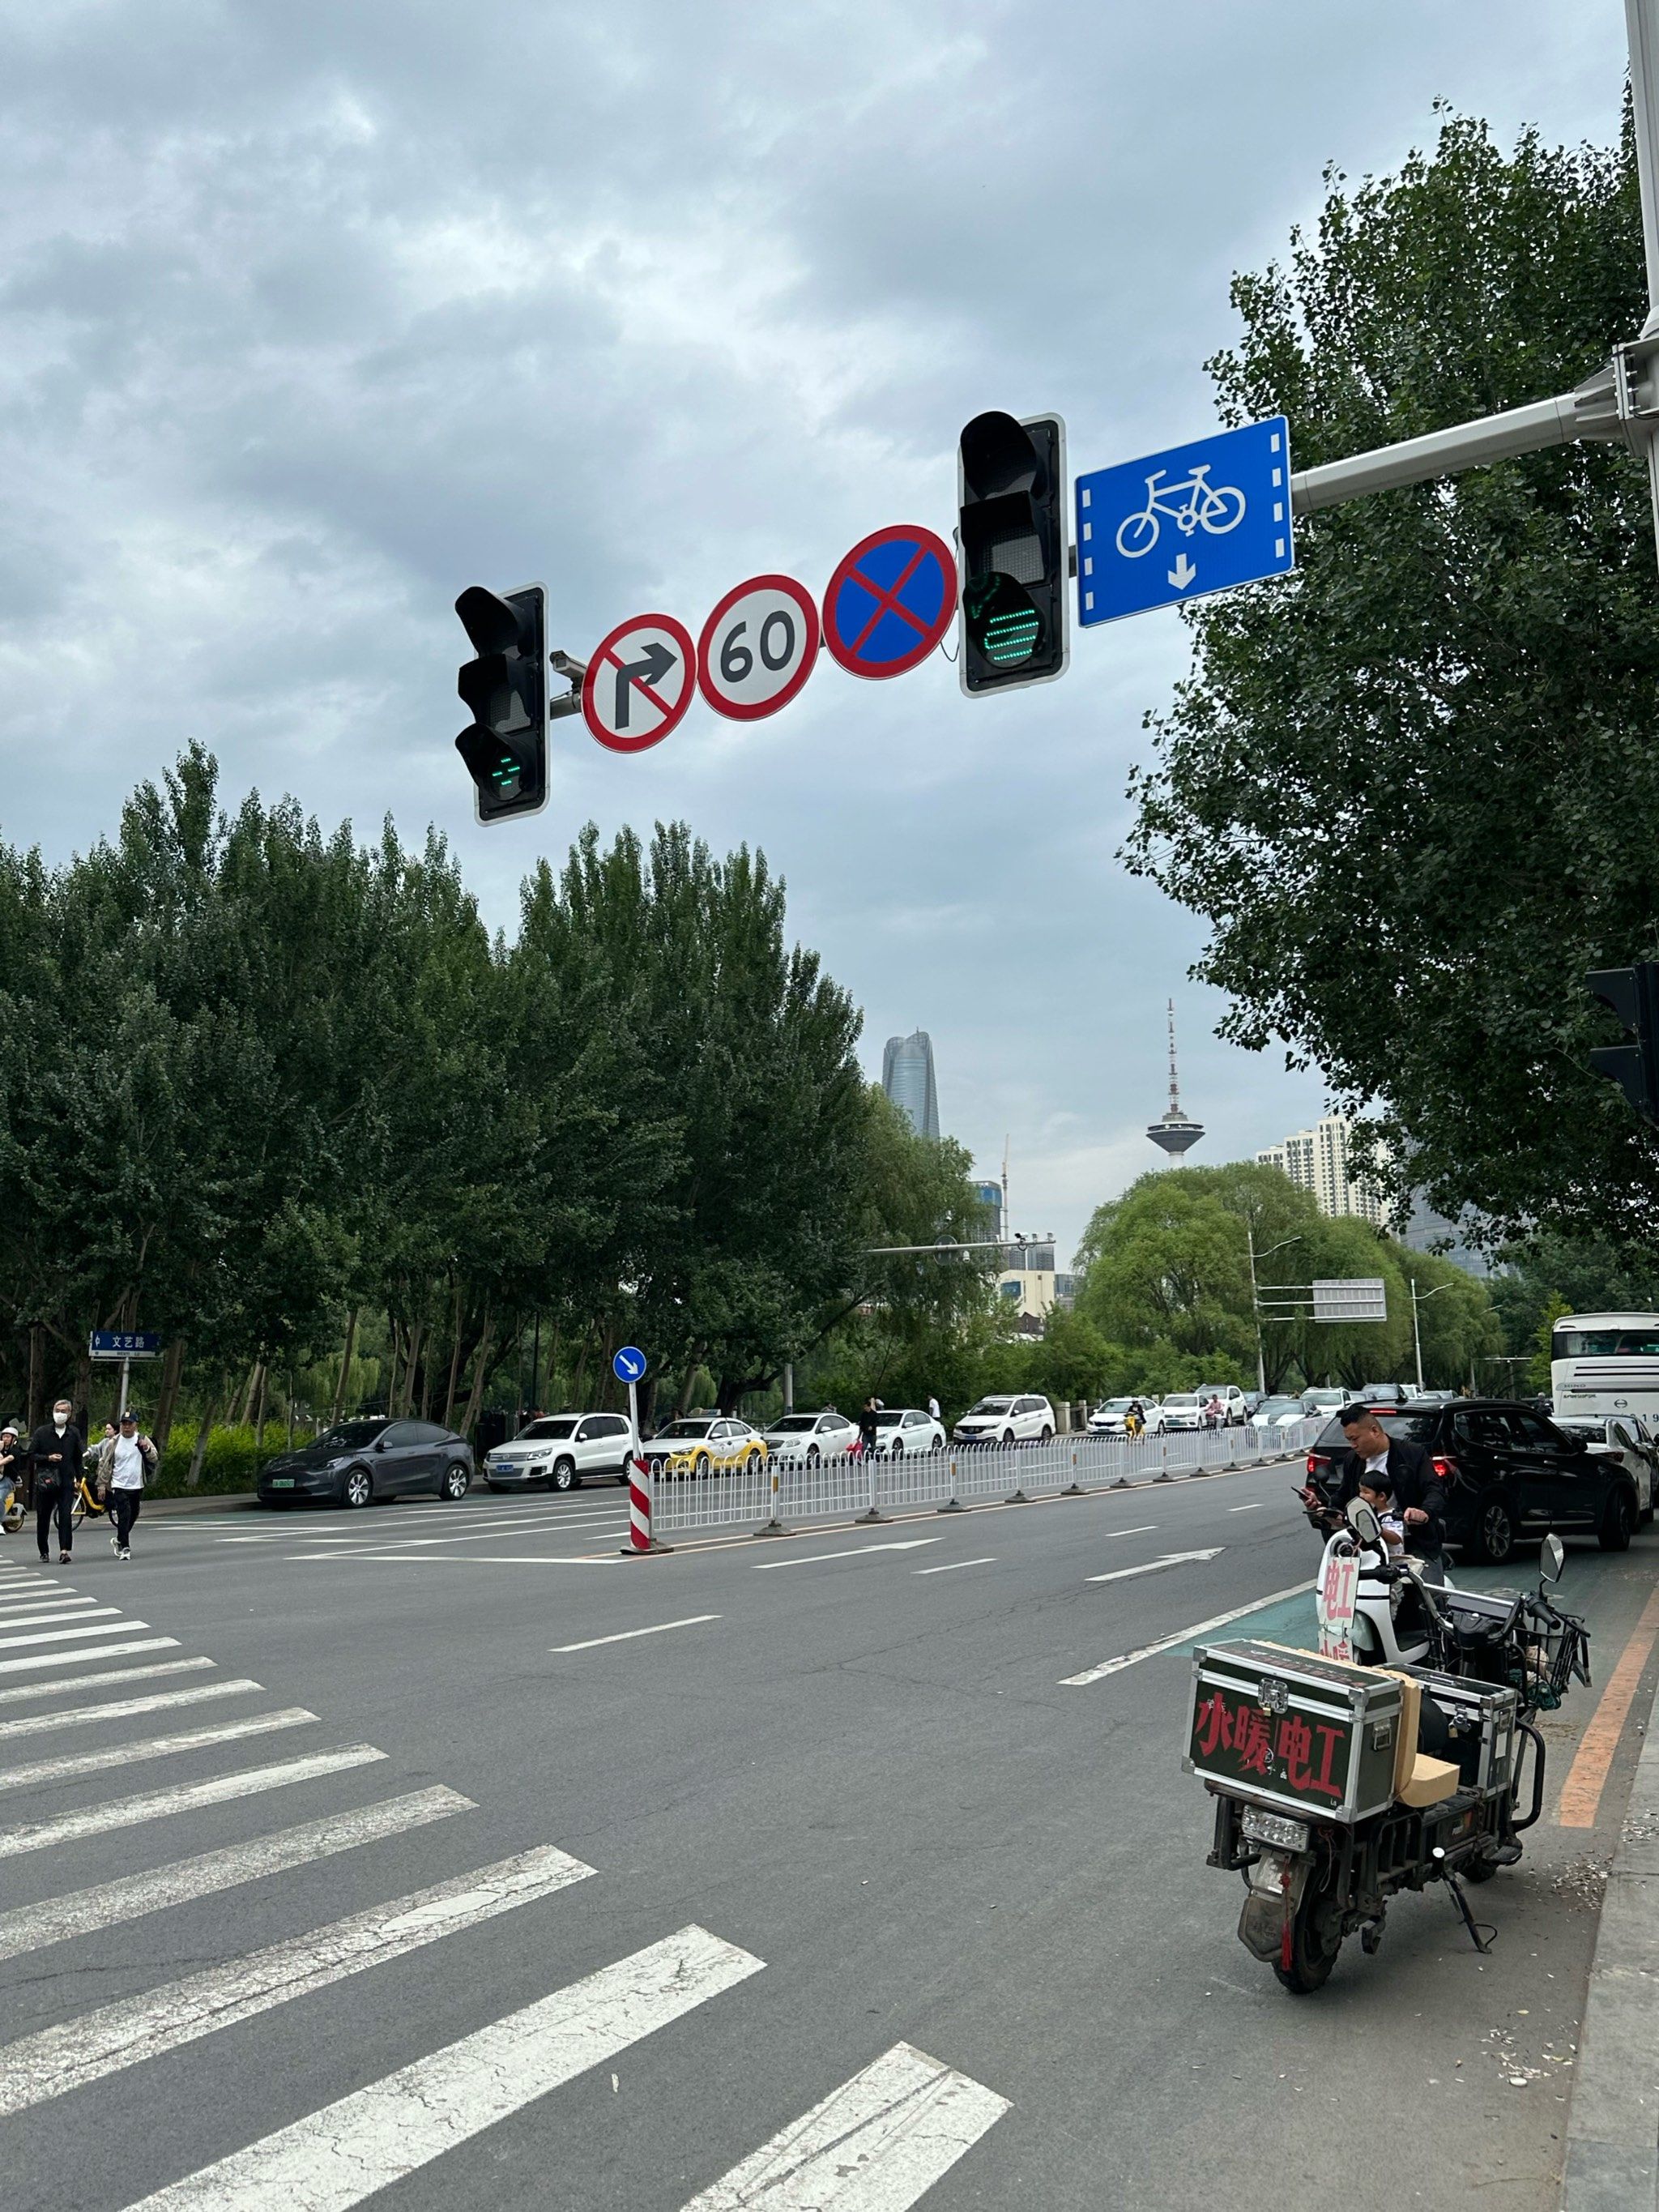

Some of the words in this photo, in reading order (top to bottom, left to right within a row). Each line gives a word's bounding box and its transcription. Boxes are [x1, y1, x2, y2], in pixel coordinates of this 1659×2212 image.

[720, 610, 795, 683] 60
[112, 1335, 145, 1348] 文艺路
[1323, 1560, 1354, 1621] 电工
